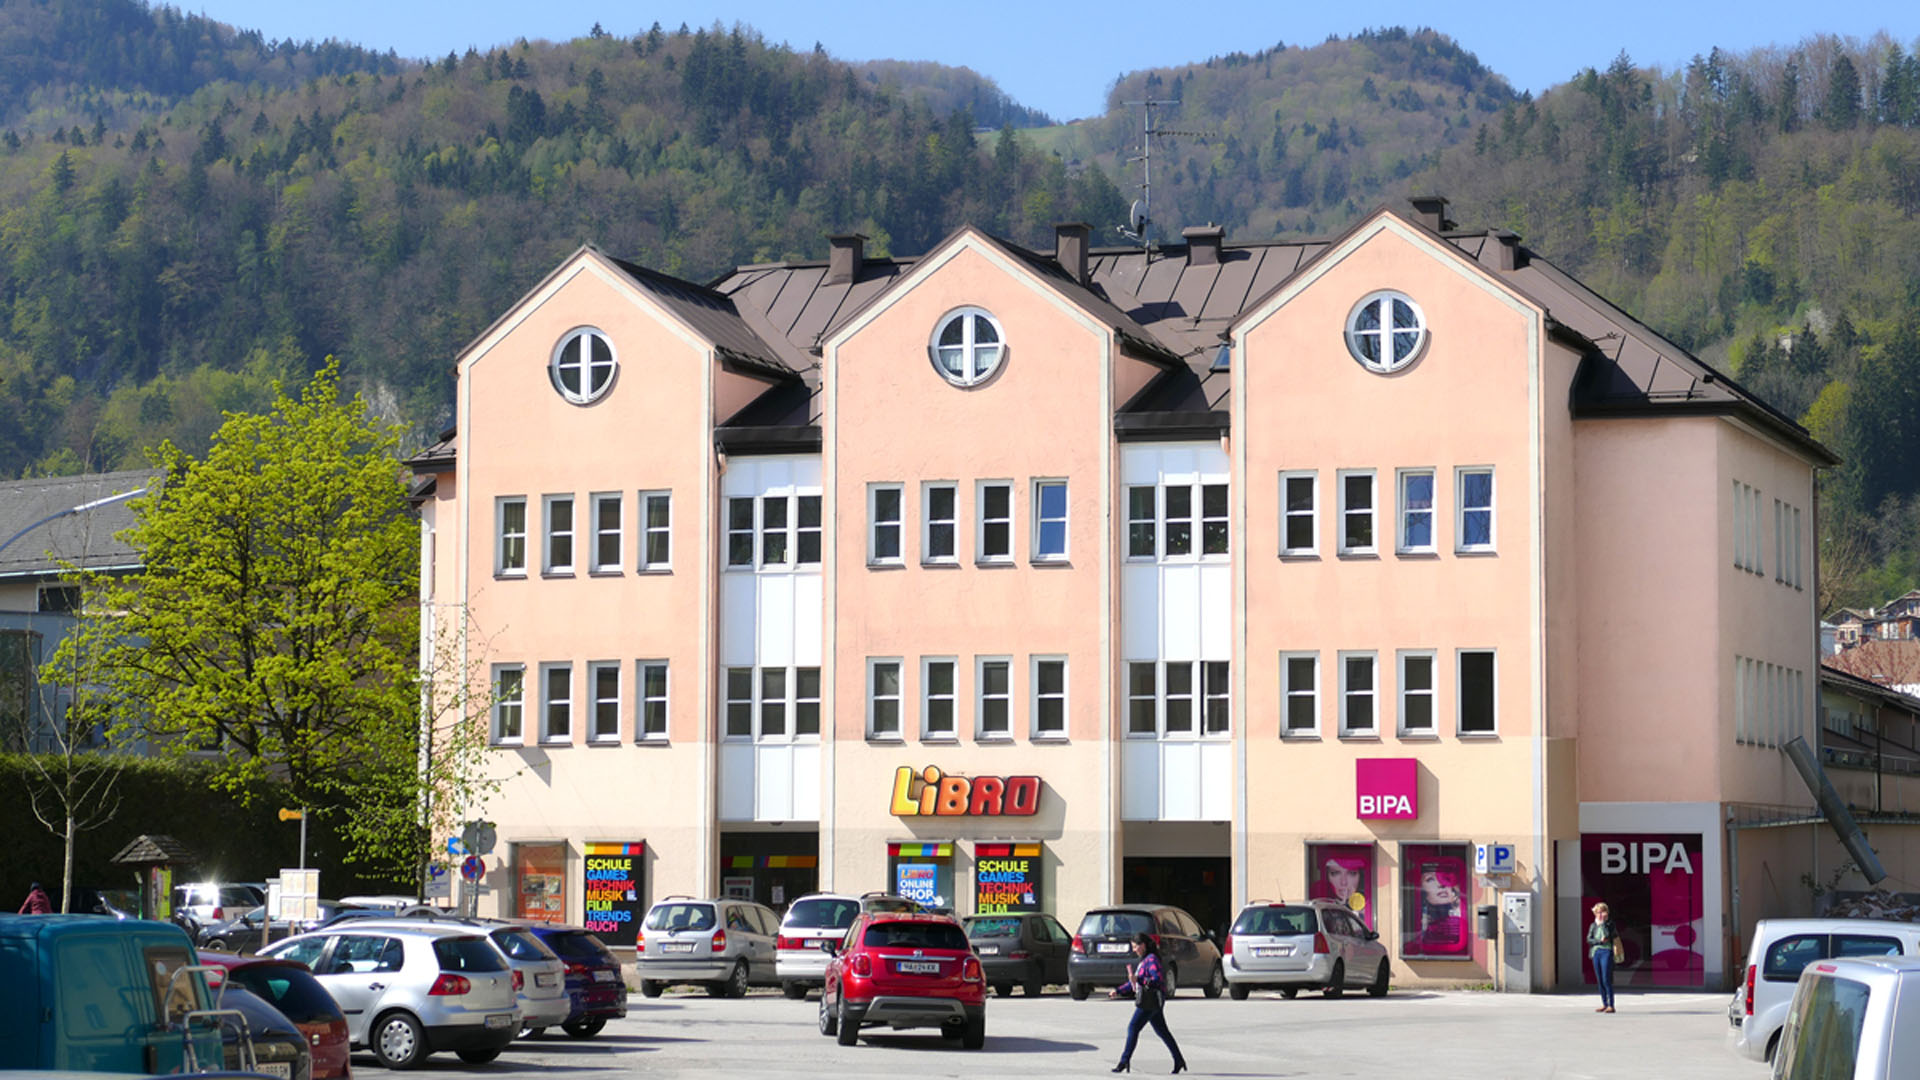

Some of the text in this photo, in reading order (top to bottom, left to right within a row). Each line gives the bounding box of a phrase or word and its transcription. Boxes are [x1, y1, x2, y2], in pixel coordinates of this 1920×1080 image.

[1360, 795, 1412, 814] BIPA
[1494, 847, 1510, 865] P
[1601, 842, 1694, 874] BIPA
[586, 859, 632, 870] SCHULE
[978, 861, 1029, 872] SCHULE
[586, 870, 628, 880] GAMES
[978, 872, 1025, 882] GAMES
[587, 880, 636, 891] TECHNIK
[900, 880, 934, 889] ONLINE
[979, 882, 1034, 893] TECHNIK
[586, 890, 624, 901] MUSIK
[900, 889, 934, 900] SHOP
[978, 893, 1020, 904] MUSIK
[586, 900, 612, 911] FILM
[978, 904, 1007, 914] FILM
[586, 911, 632, 922] TRENDS
